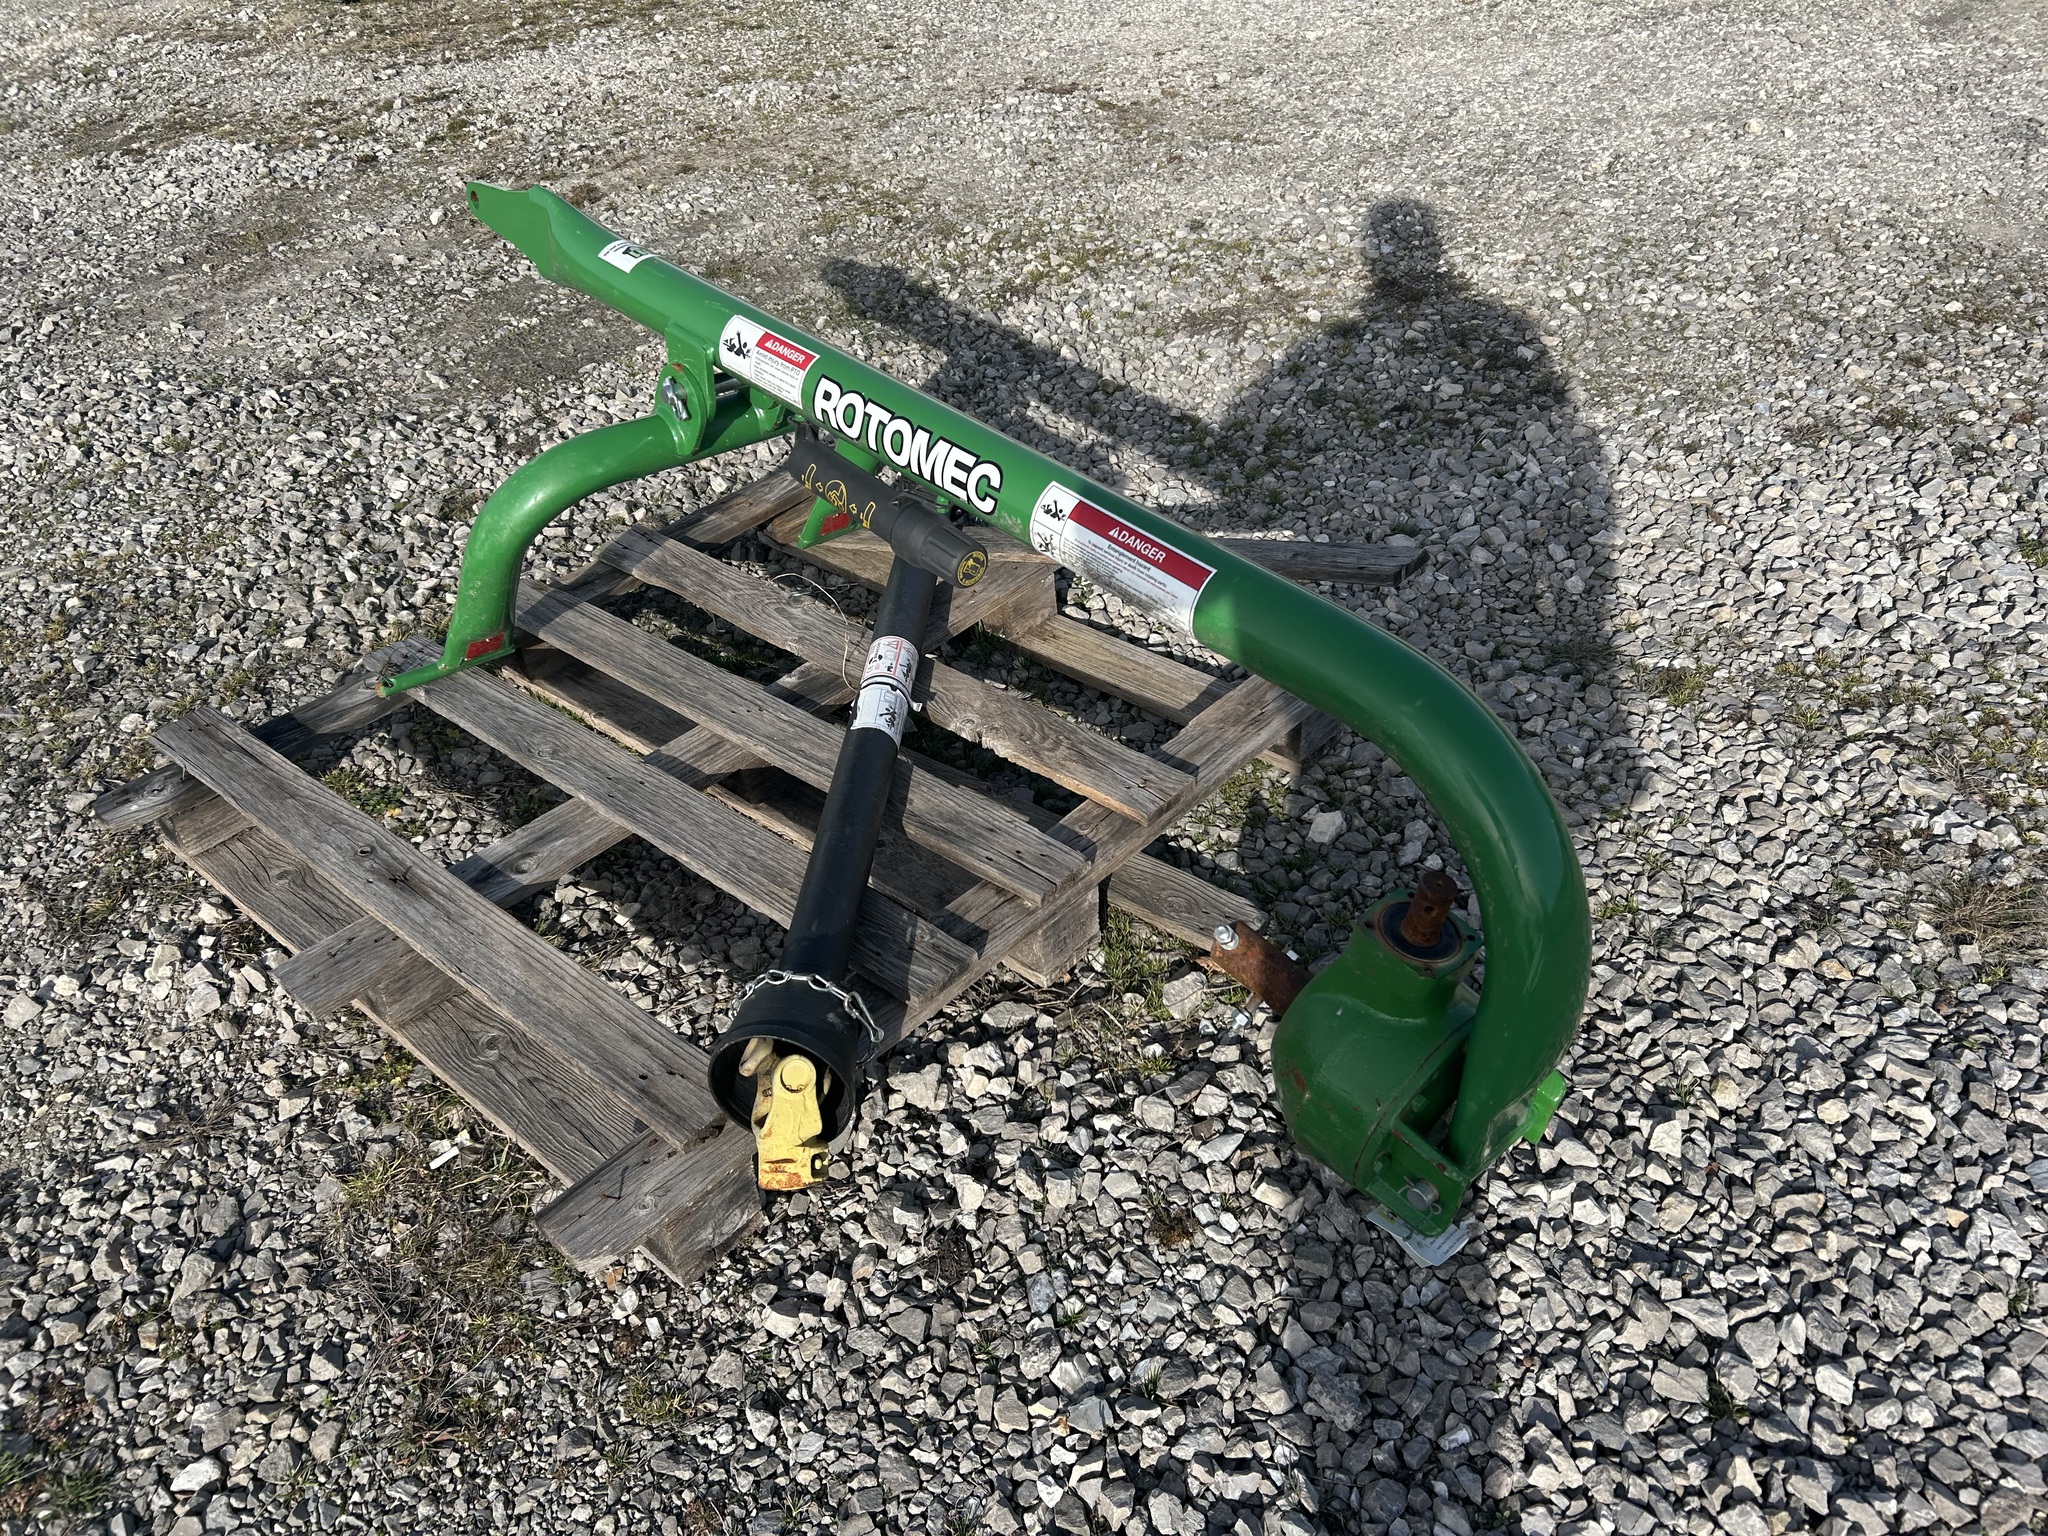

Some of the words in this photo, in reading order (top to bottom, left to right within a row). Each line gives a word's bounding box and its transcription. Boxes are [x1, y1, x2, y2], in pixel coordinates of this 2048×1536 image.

[772, 340, 806, 364] DANGER
[780, 362, 791, 371] from
[790, 366, 801, 376] PTO
[813, 374, 1003, 515] ROTOMEC
[1118, 530, 1166, 563] DANGER
